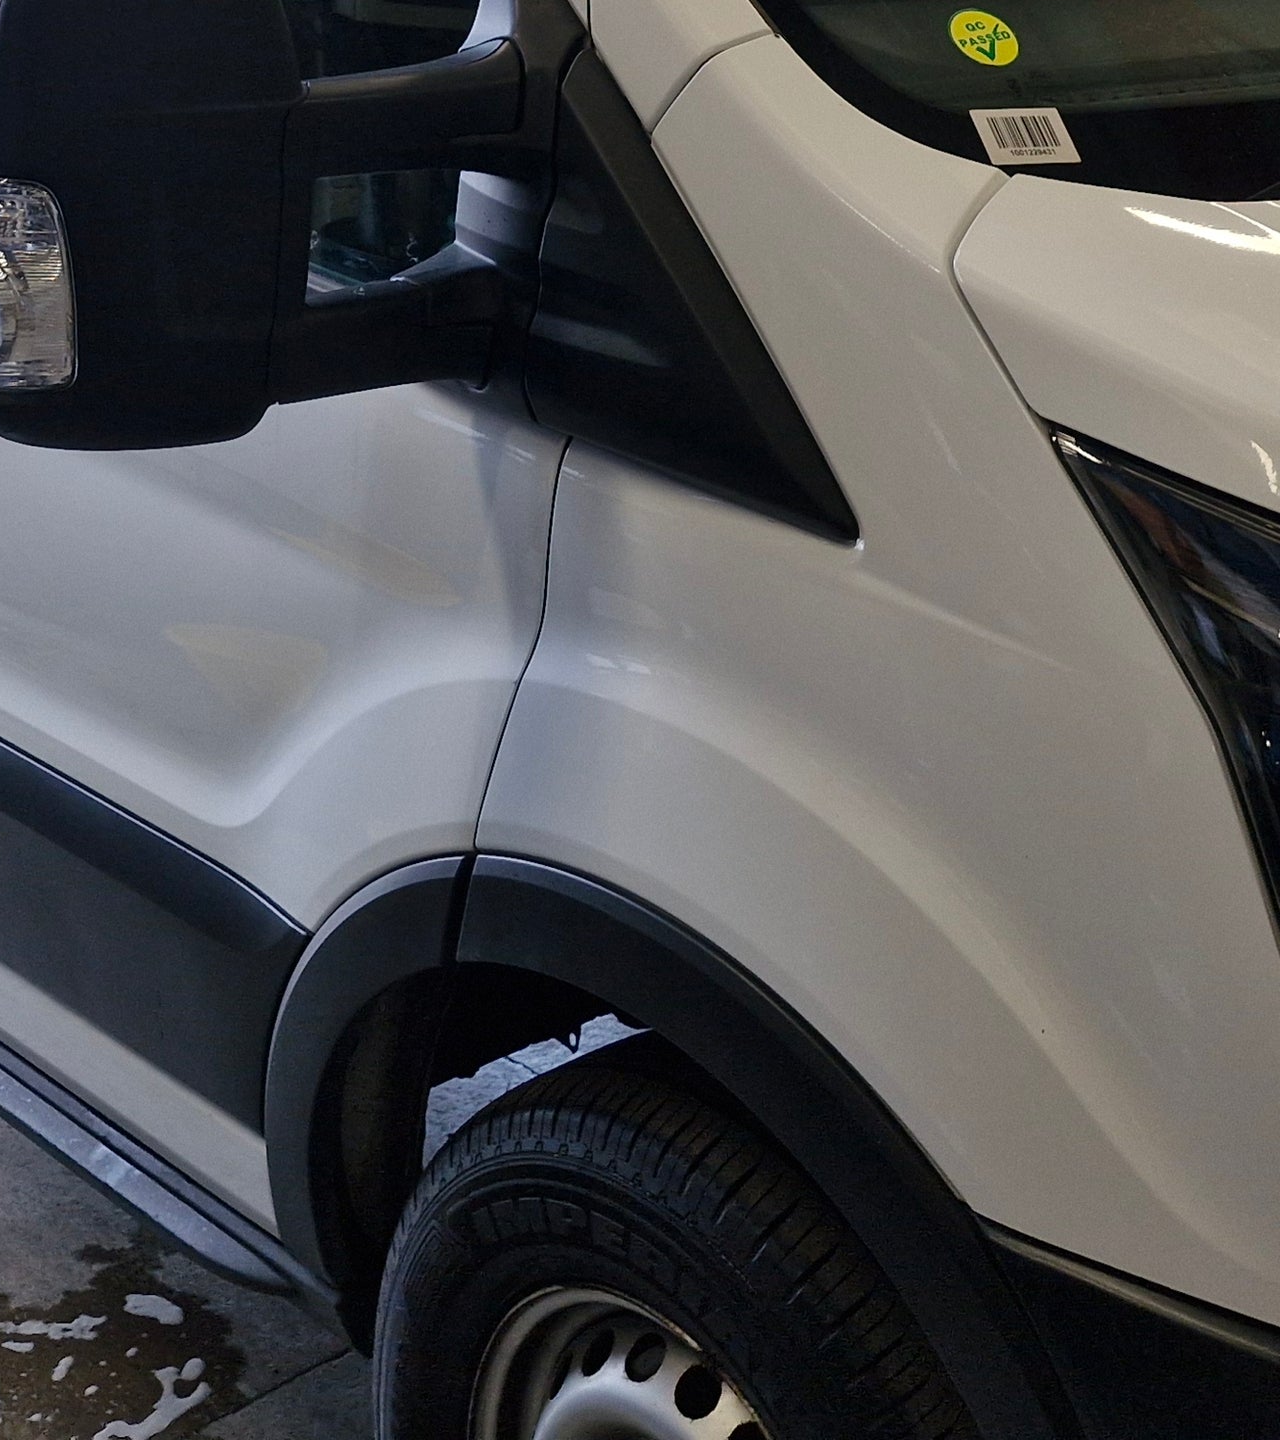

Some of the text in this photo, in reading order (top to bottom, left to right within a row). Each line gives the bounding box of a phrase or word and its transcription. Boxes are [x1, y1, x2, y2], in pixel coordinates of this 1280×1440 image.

[965, 21, 985, 32] QC
[958, 31, 1010, 47] PASSED
[1010, 149, 1056, 157] 1001229431
